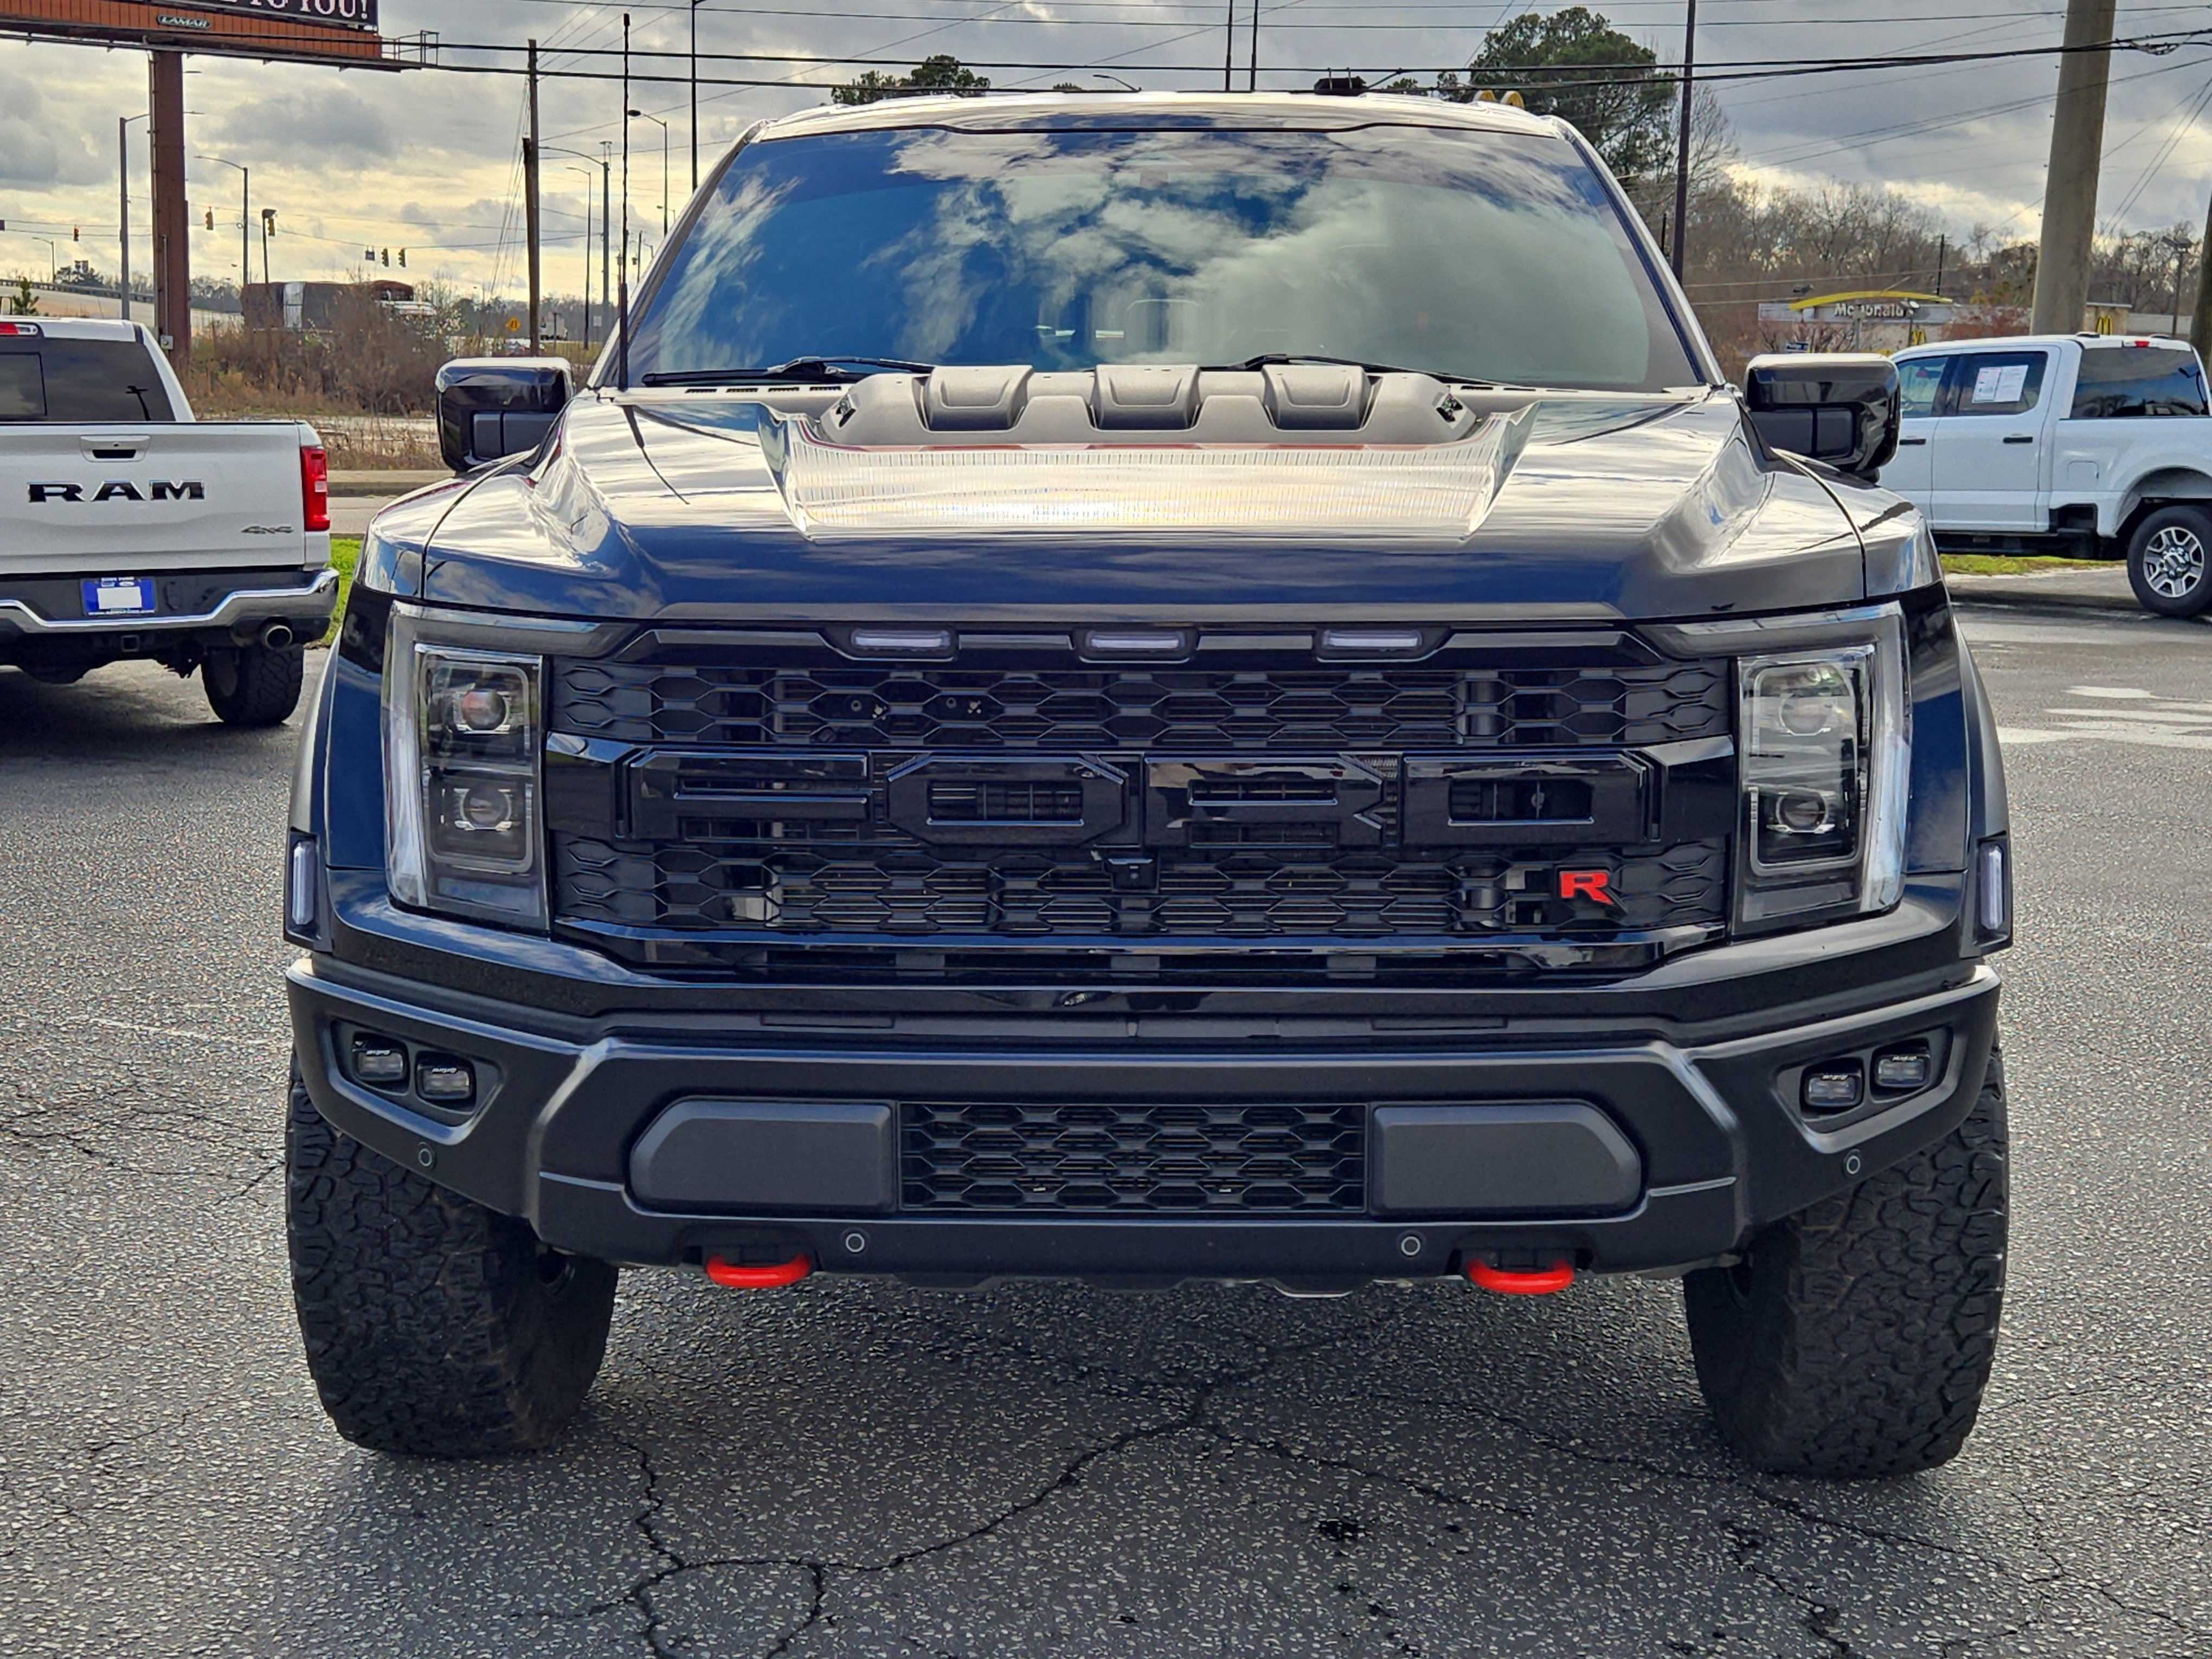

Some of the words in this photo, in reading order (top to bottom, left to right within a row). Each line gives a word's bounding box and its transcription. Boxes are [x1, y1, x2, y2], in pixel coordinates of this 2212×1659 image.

[162, 17, 207, 27] LAMAR
[1835, 302, 1914, 318] Mconald
[27, 479, 205, 504] RAM
[629, 750, 1647, 847] FORD
[1559, 870, 1613, 905] R
